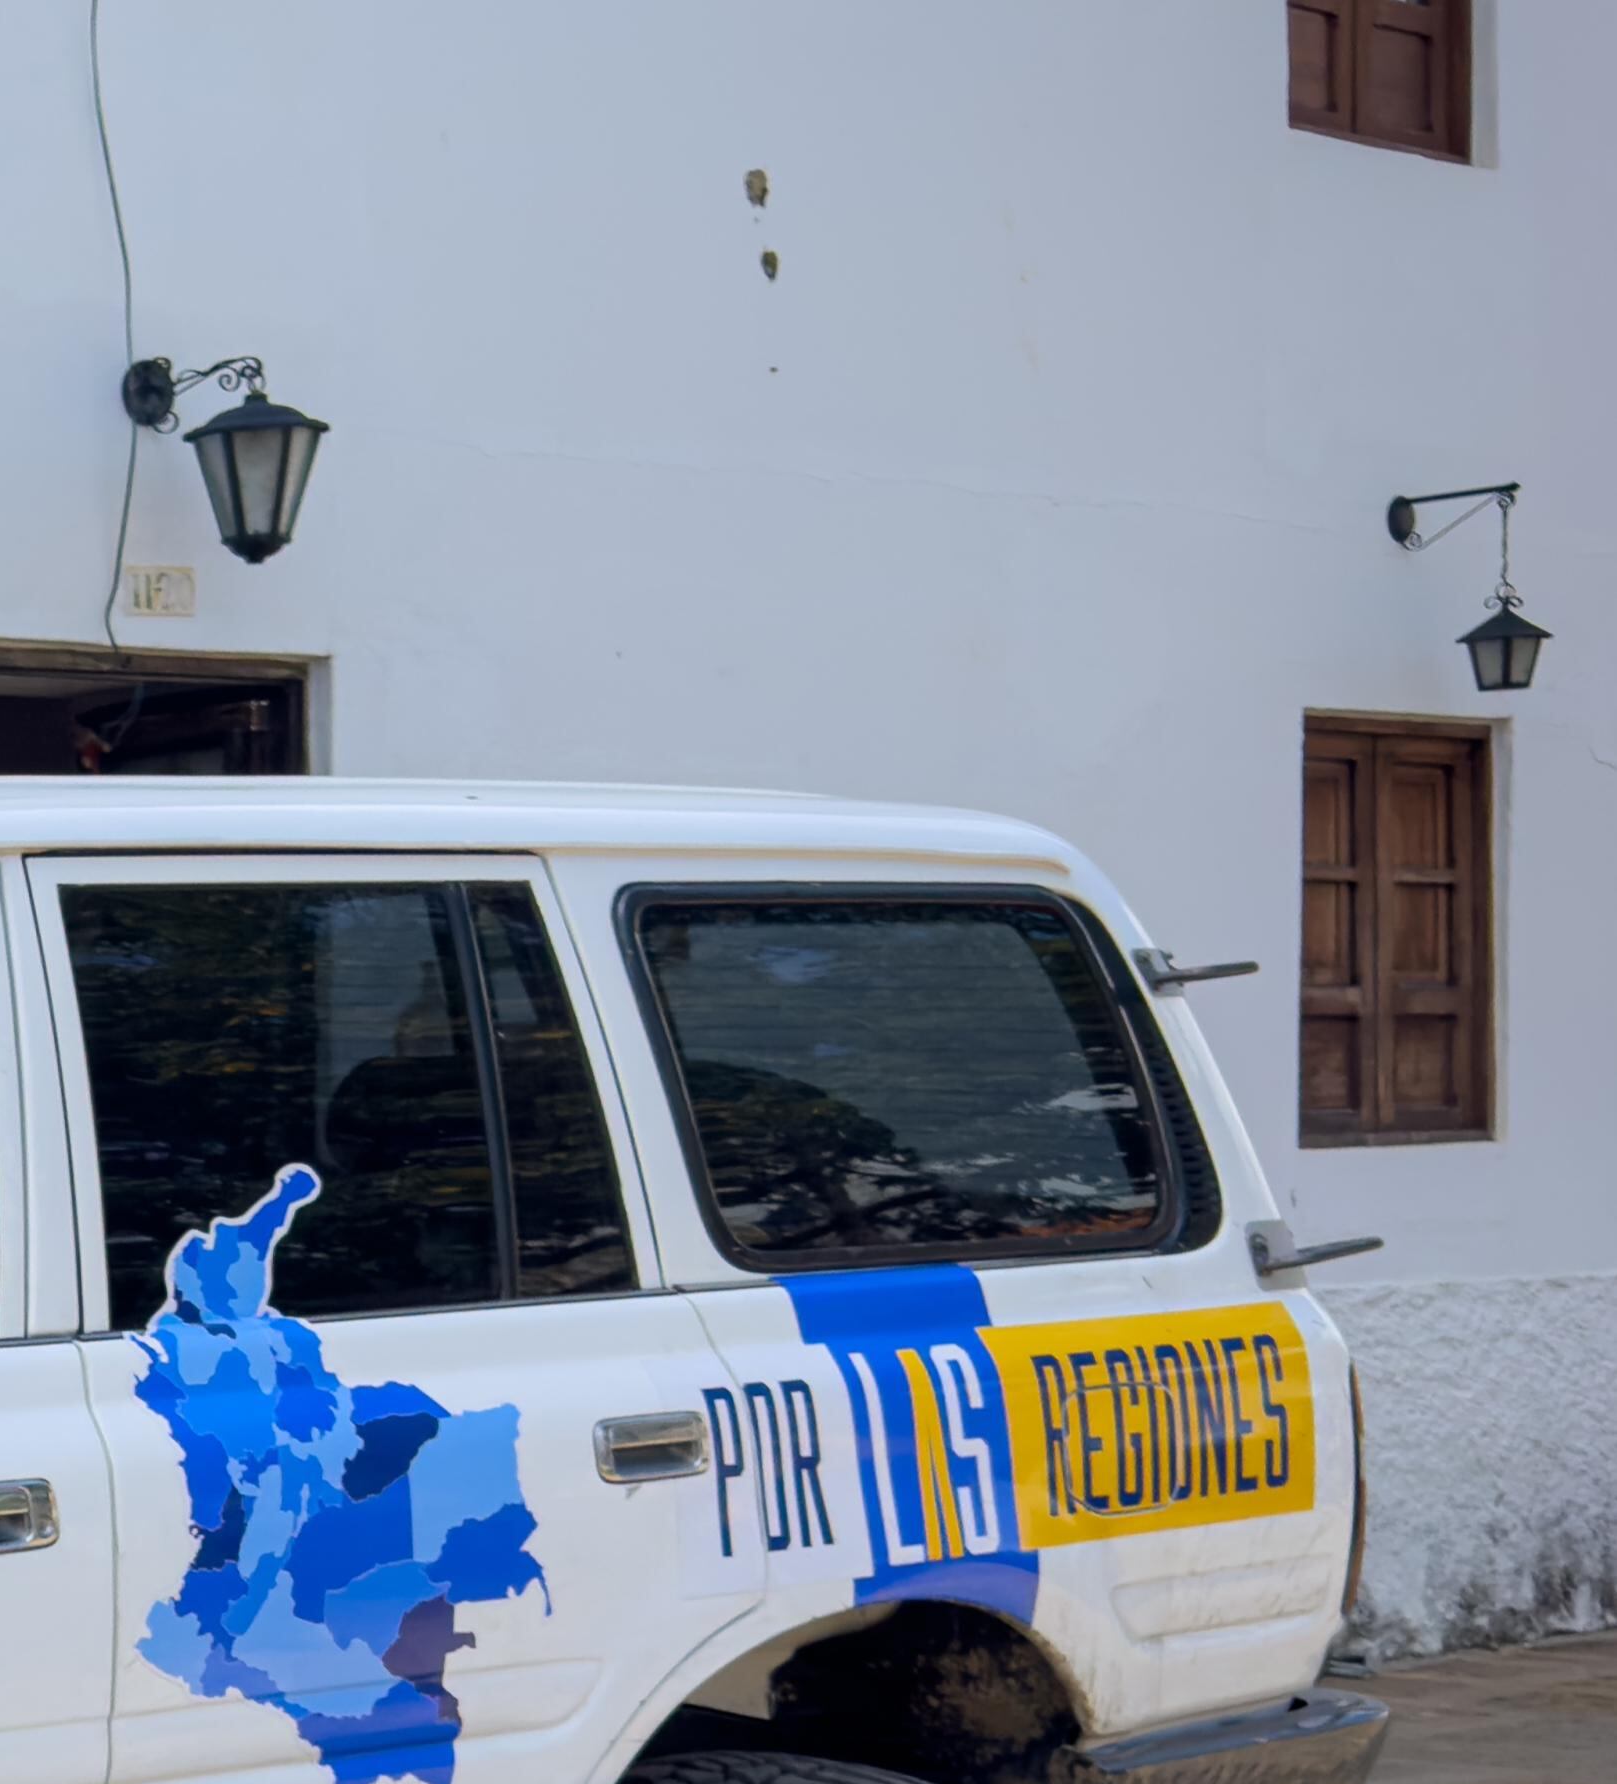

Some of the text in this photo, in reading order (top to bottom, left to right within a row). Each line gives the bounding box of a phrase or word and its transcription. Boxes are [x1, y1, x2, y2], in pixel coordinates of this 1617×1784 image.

[700, 1333, 1290, 1567] POR LAS REGIONES
